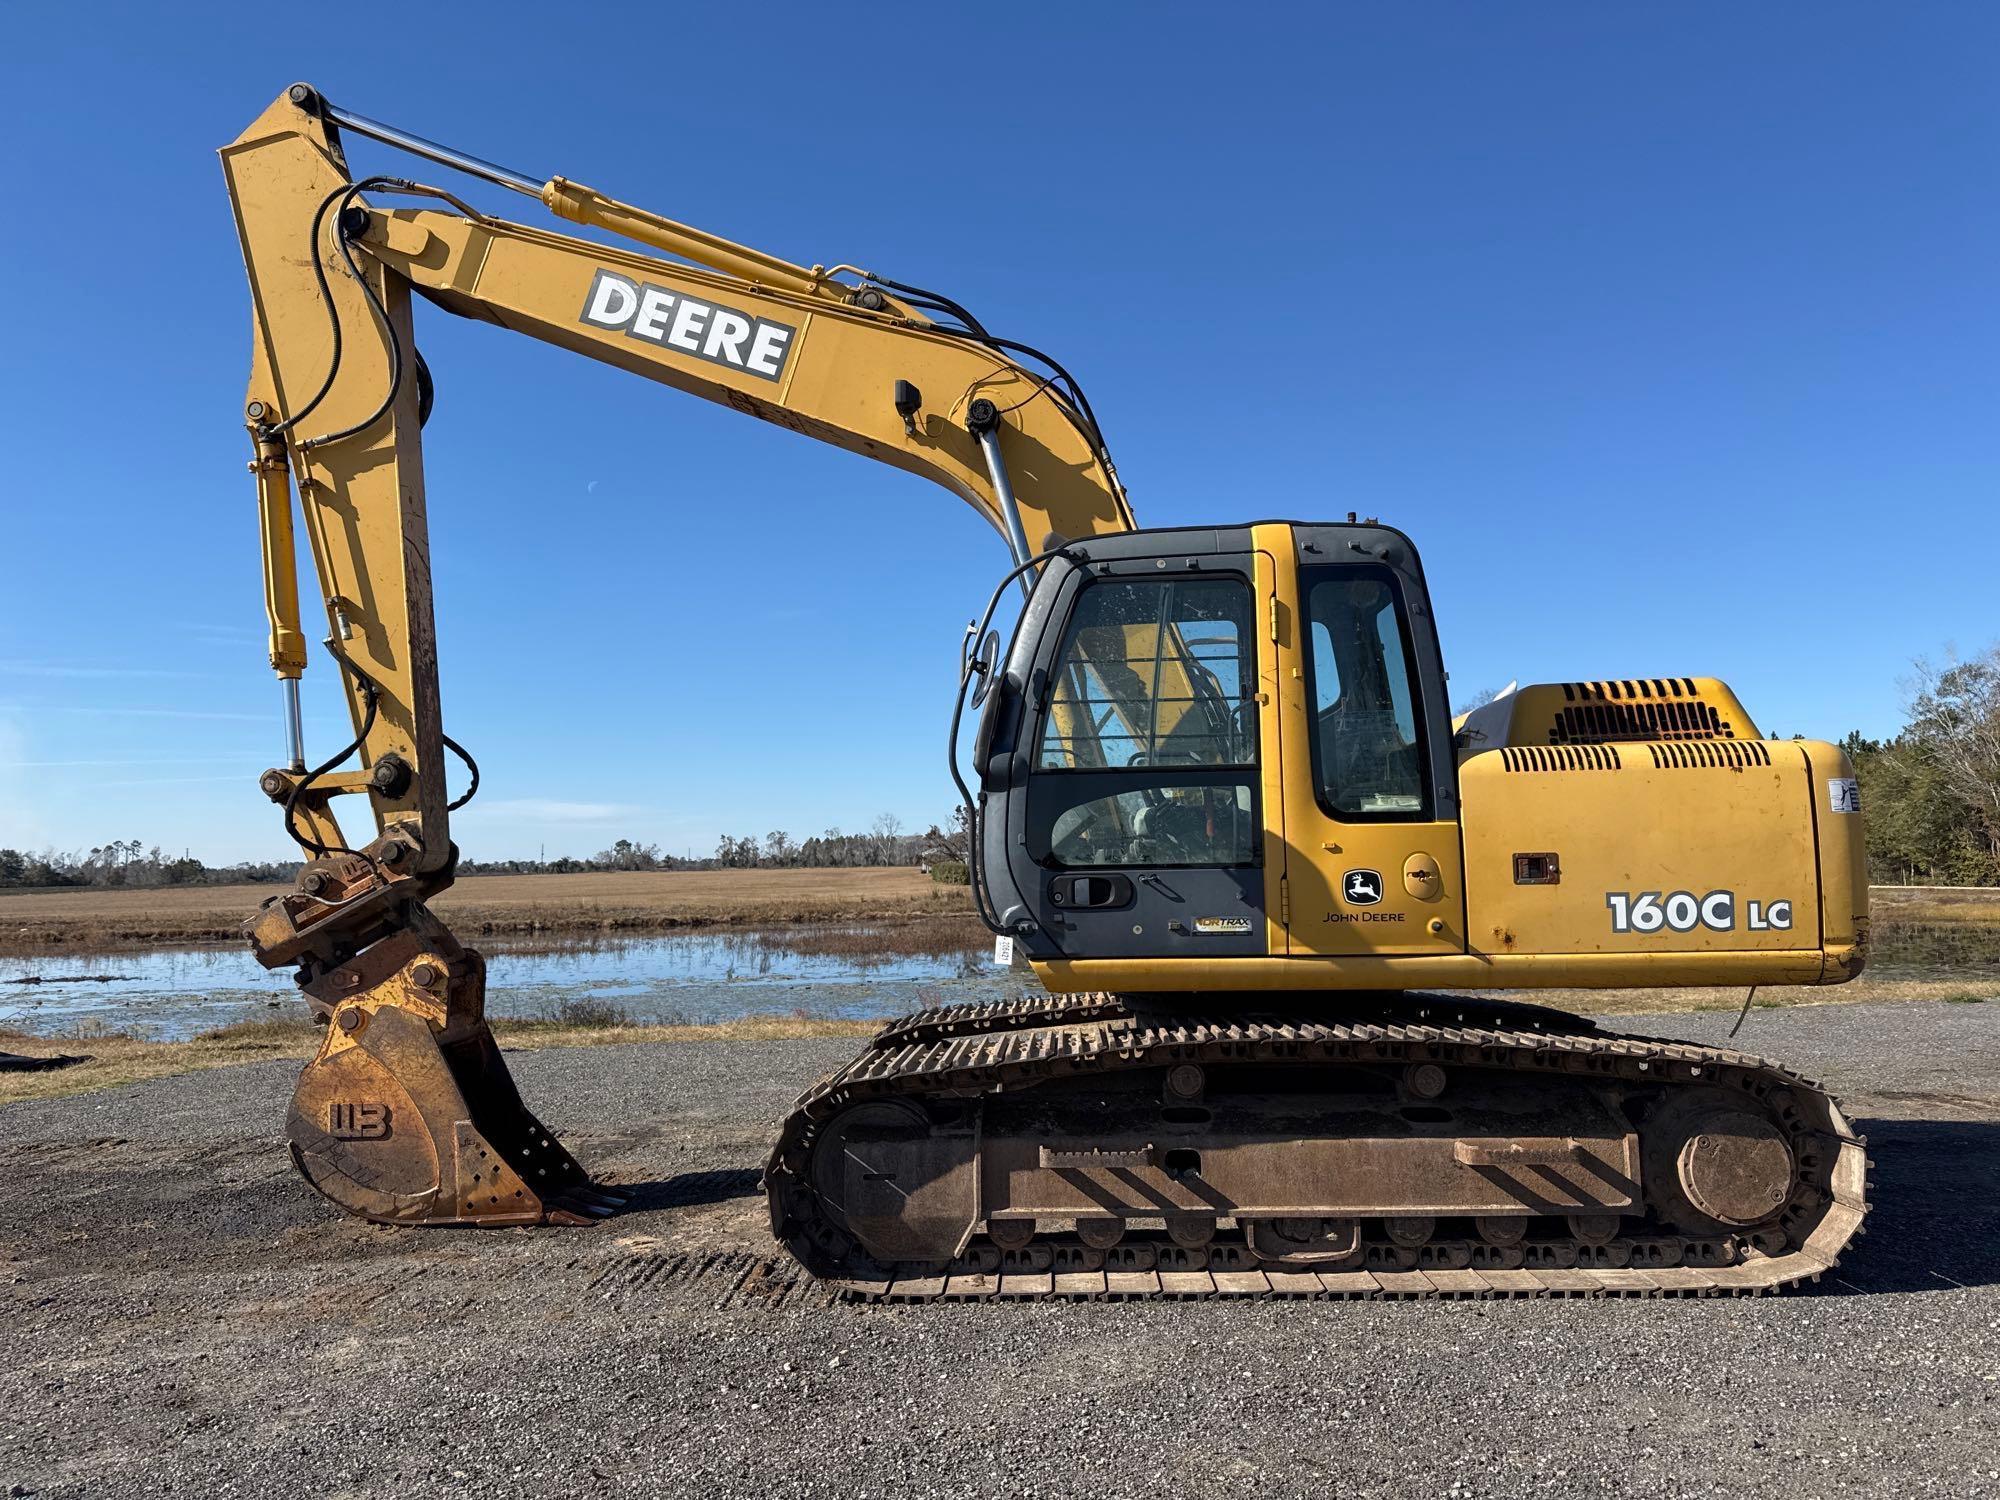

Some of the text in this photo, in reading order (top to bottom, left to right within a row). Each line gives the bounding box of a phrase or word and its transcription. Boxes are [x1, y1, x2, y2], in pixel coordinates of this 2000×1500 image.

[588, 275, 789, 376] DEERE
[1323, 912, 1405, 922] JOHN DEERE
[1610, 893, 1790, 930] 160C LC
